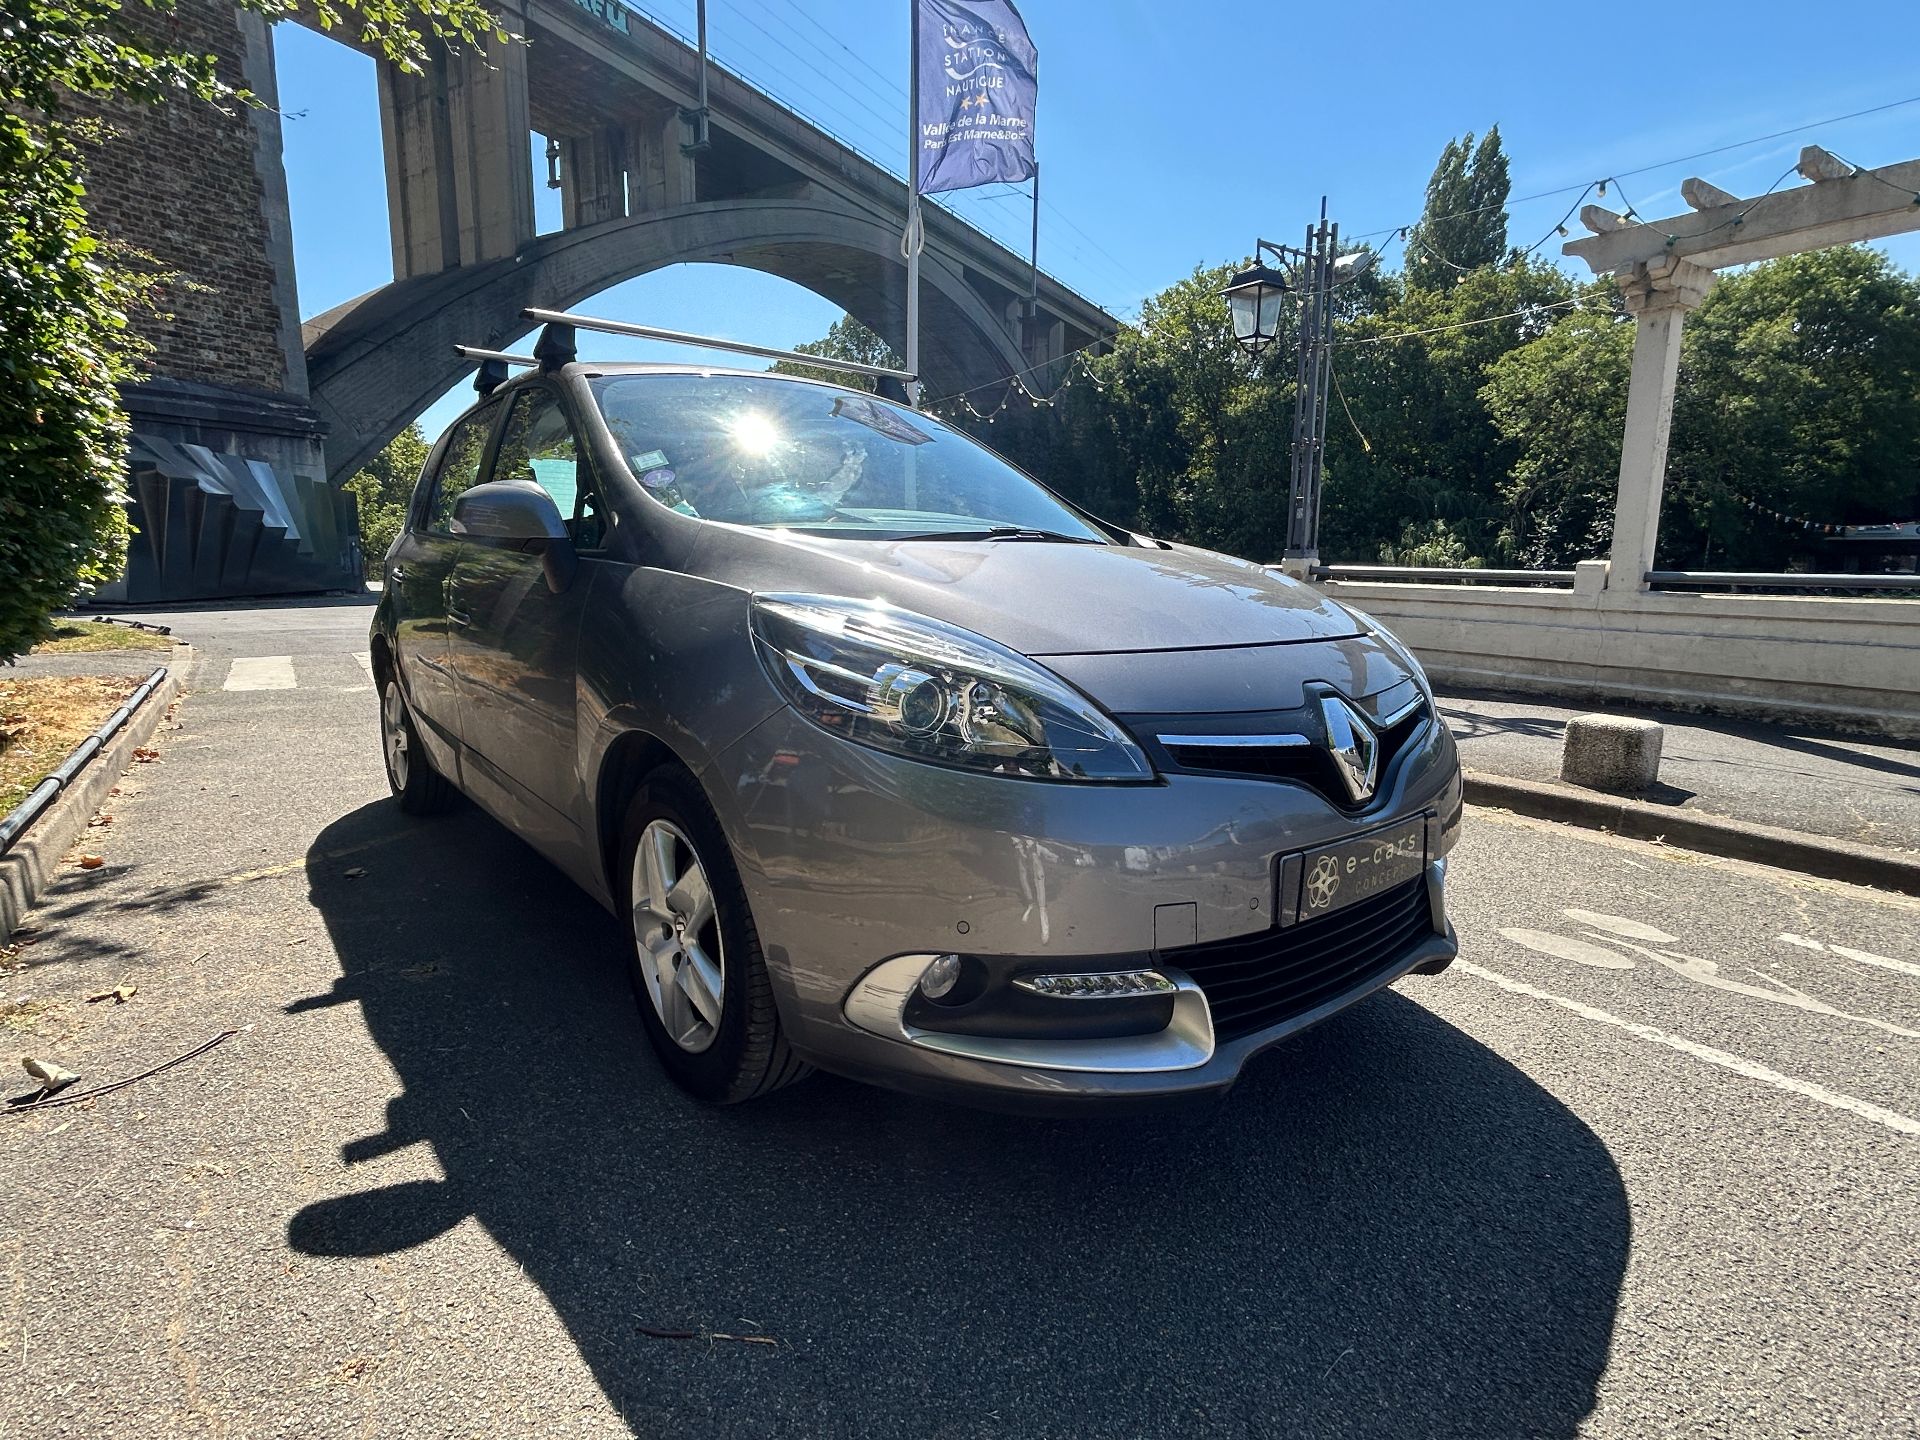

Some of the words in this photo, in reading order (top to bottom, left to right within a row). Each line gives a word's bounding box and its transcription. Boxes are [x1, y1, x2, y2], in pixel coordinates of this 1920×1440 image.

[944, 47, 1006, 67] STATION
[946, 76, 1004, 98] NAUTIQUE
[958, 115, 972, 127] de
[975, 113, 987, 125] la
[989, 113, 1027, 127] Marne
[948, 131, 962, 143] Est
[1346, 834, 1416, 873] e-cars
[1355, 863, 1409, 895] CONCEPT
